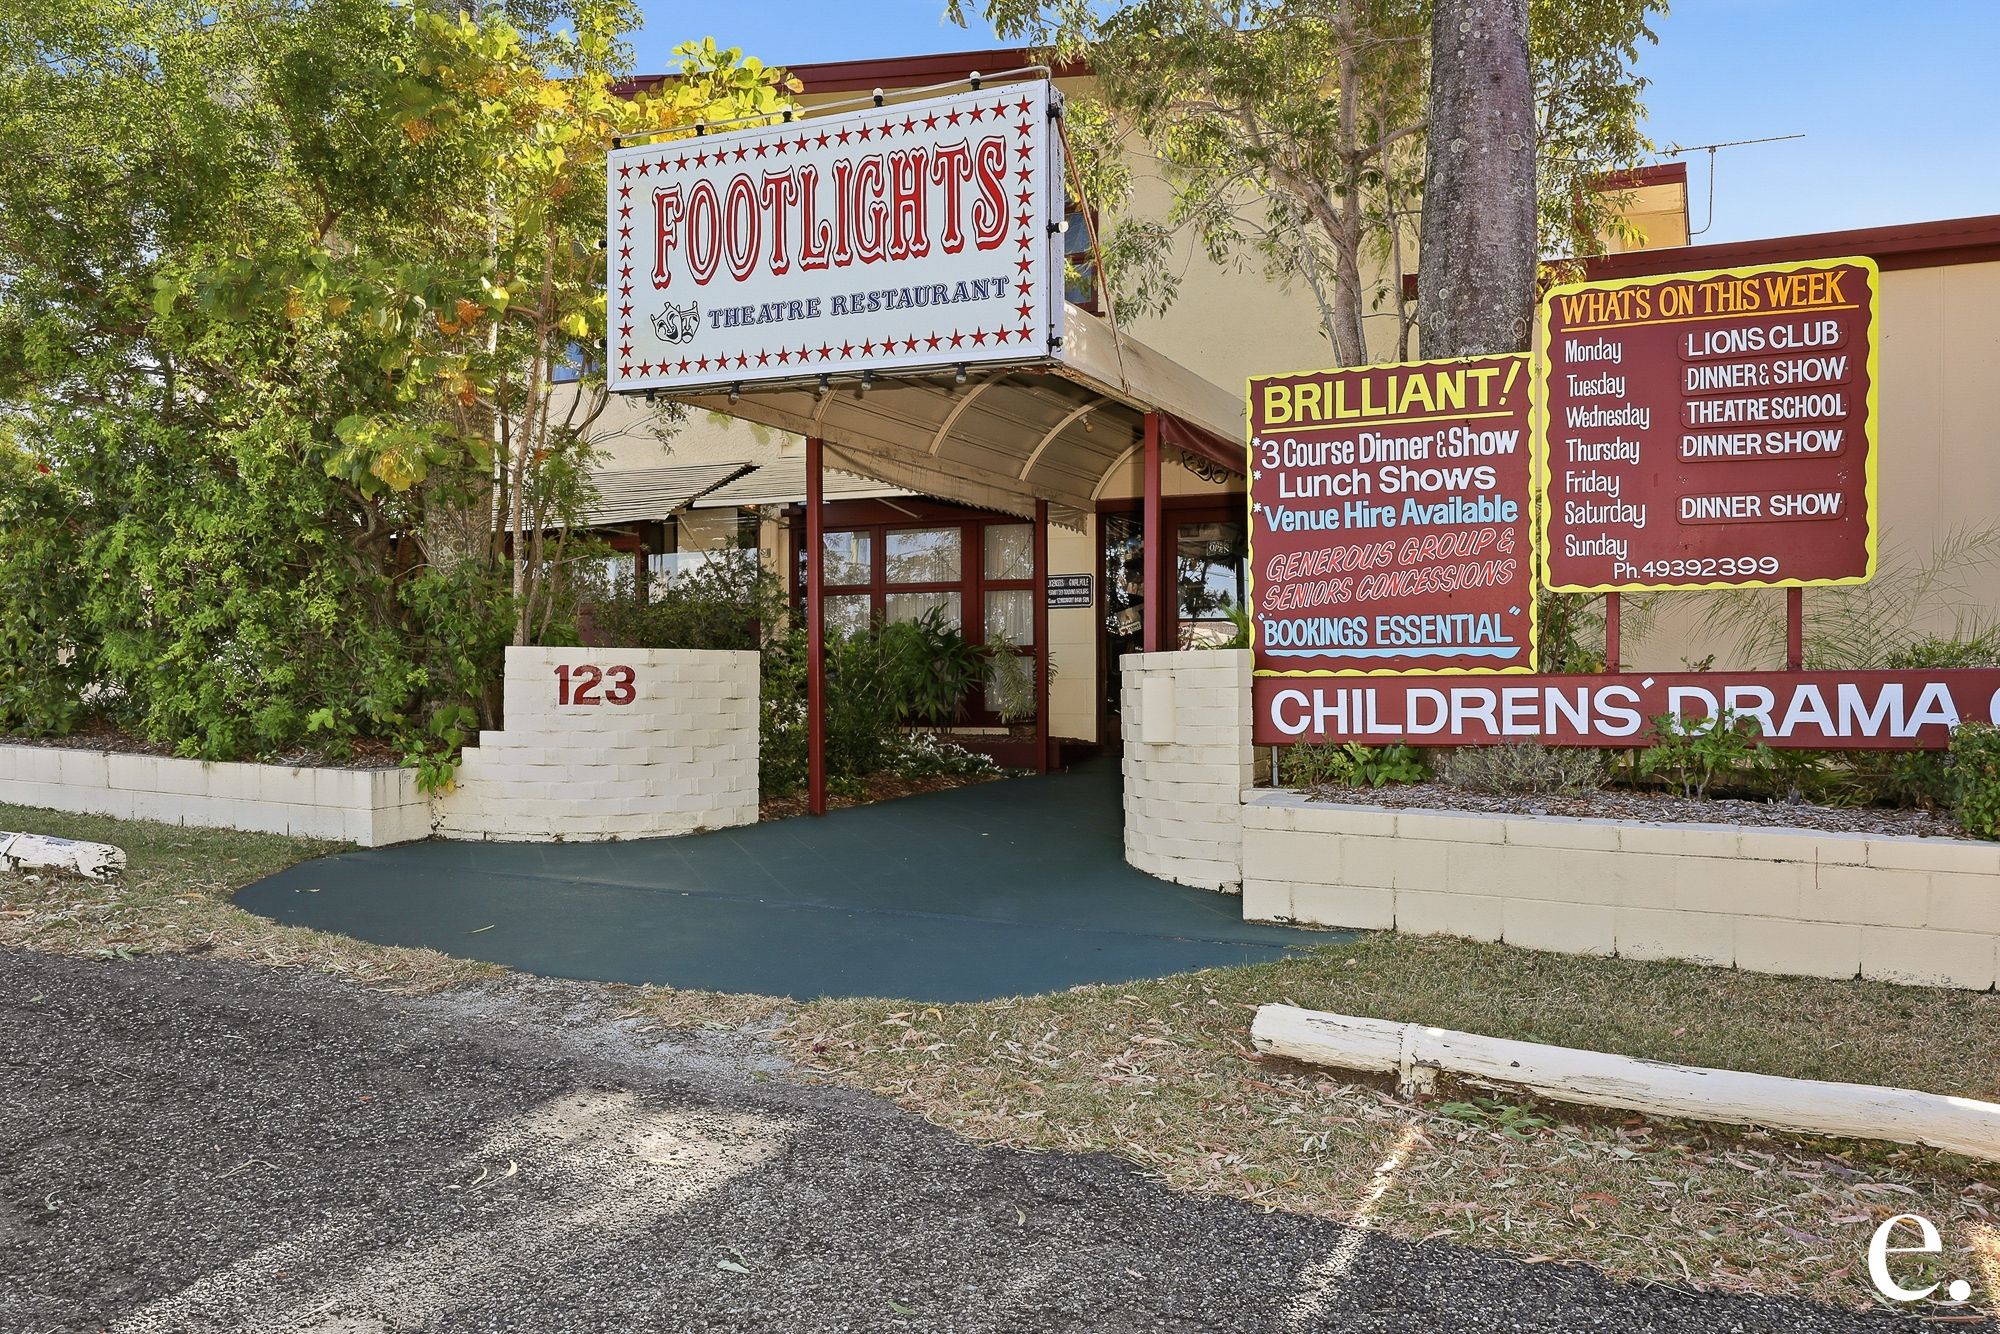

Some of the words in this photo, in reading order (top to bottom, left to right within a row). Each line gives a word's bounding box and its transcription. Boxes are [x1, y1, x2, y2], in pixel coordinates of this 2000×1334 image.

[650, 135, 1010, 289] FOOTLIGHTS
[708, 296, 822, 329] THEATRE
[830, 276, 1010, 317] RESTAURANT
[1658, 287, 1696, 317] ON
[1698, 279, 1761, 313] THIS
[1764, 270, 1848, 308] WEEK
[1565, 340, 1622, 364] Monday
[1688, 328, 1766, 357] LIONS
[1768, 320, 1839, 348] CLUB
[1567, 374, 1627, 399] Tuesday
[1687, 364, 1759, 391] DINNER
[1773, 356, 1847, 383] SHOW
[1263, 361, 1521, 424] BRILLIANT!
[1566, 404, 1651, 431] Wednesday
[1687, 398, 1769, 425] THEATRE
[1771, 394, 1847, 420] SCHOOL
[1261, 441, 1281, 469] 3
[1284, 438, 1355, 467] Course
[1565, 438, 1641, 465] Thursday
[1682, 434, 1762, 457] DINNER
[1765, 429, 1843, 454] SHOW
[1279, 471, 1371, 498] Lunch
[1379, 466, 1497, 494] Shows
[1566, 471, 1620, 498] Friday
[1264, 505, 1340, 532] Venue
[1344, 502, 1397, 529] Hire
[1401, 495, 1519, 526] Available
[1564, 501, 1646, 529] Saturday
[1682, 496, 1761, 519] DINNER
[1769, 493, 1841, 517] SHOW
[1266, 541, 1396, 582] GENEROUS
[1398, 528, 1496, 565] GROUP
[1496, 528, 1516, 553] &
[1565, 536, 1628, 561] Sunday
[1263, 577, 1353, 611] SENIORS
[1356, 559, 1517, 602] CONCESSIONS
[554, 664, 636, 705] 123
[1667, 682, 1961, 738] DRAMA
